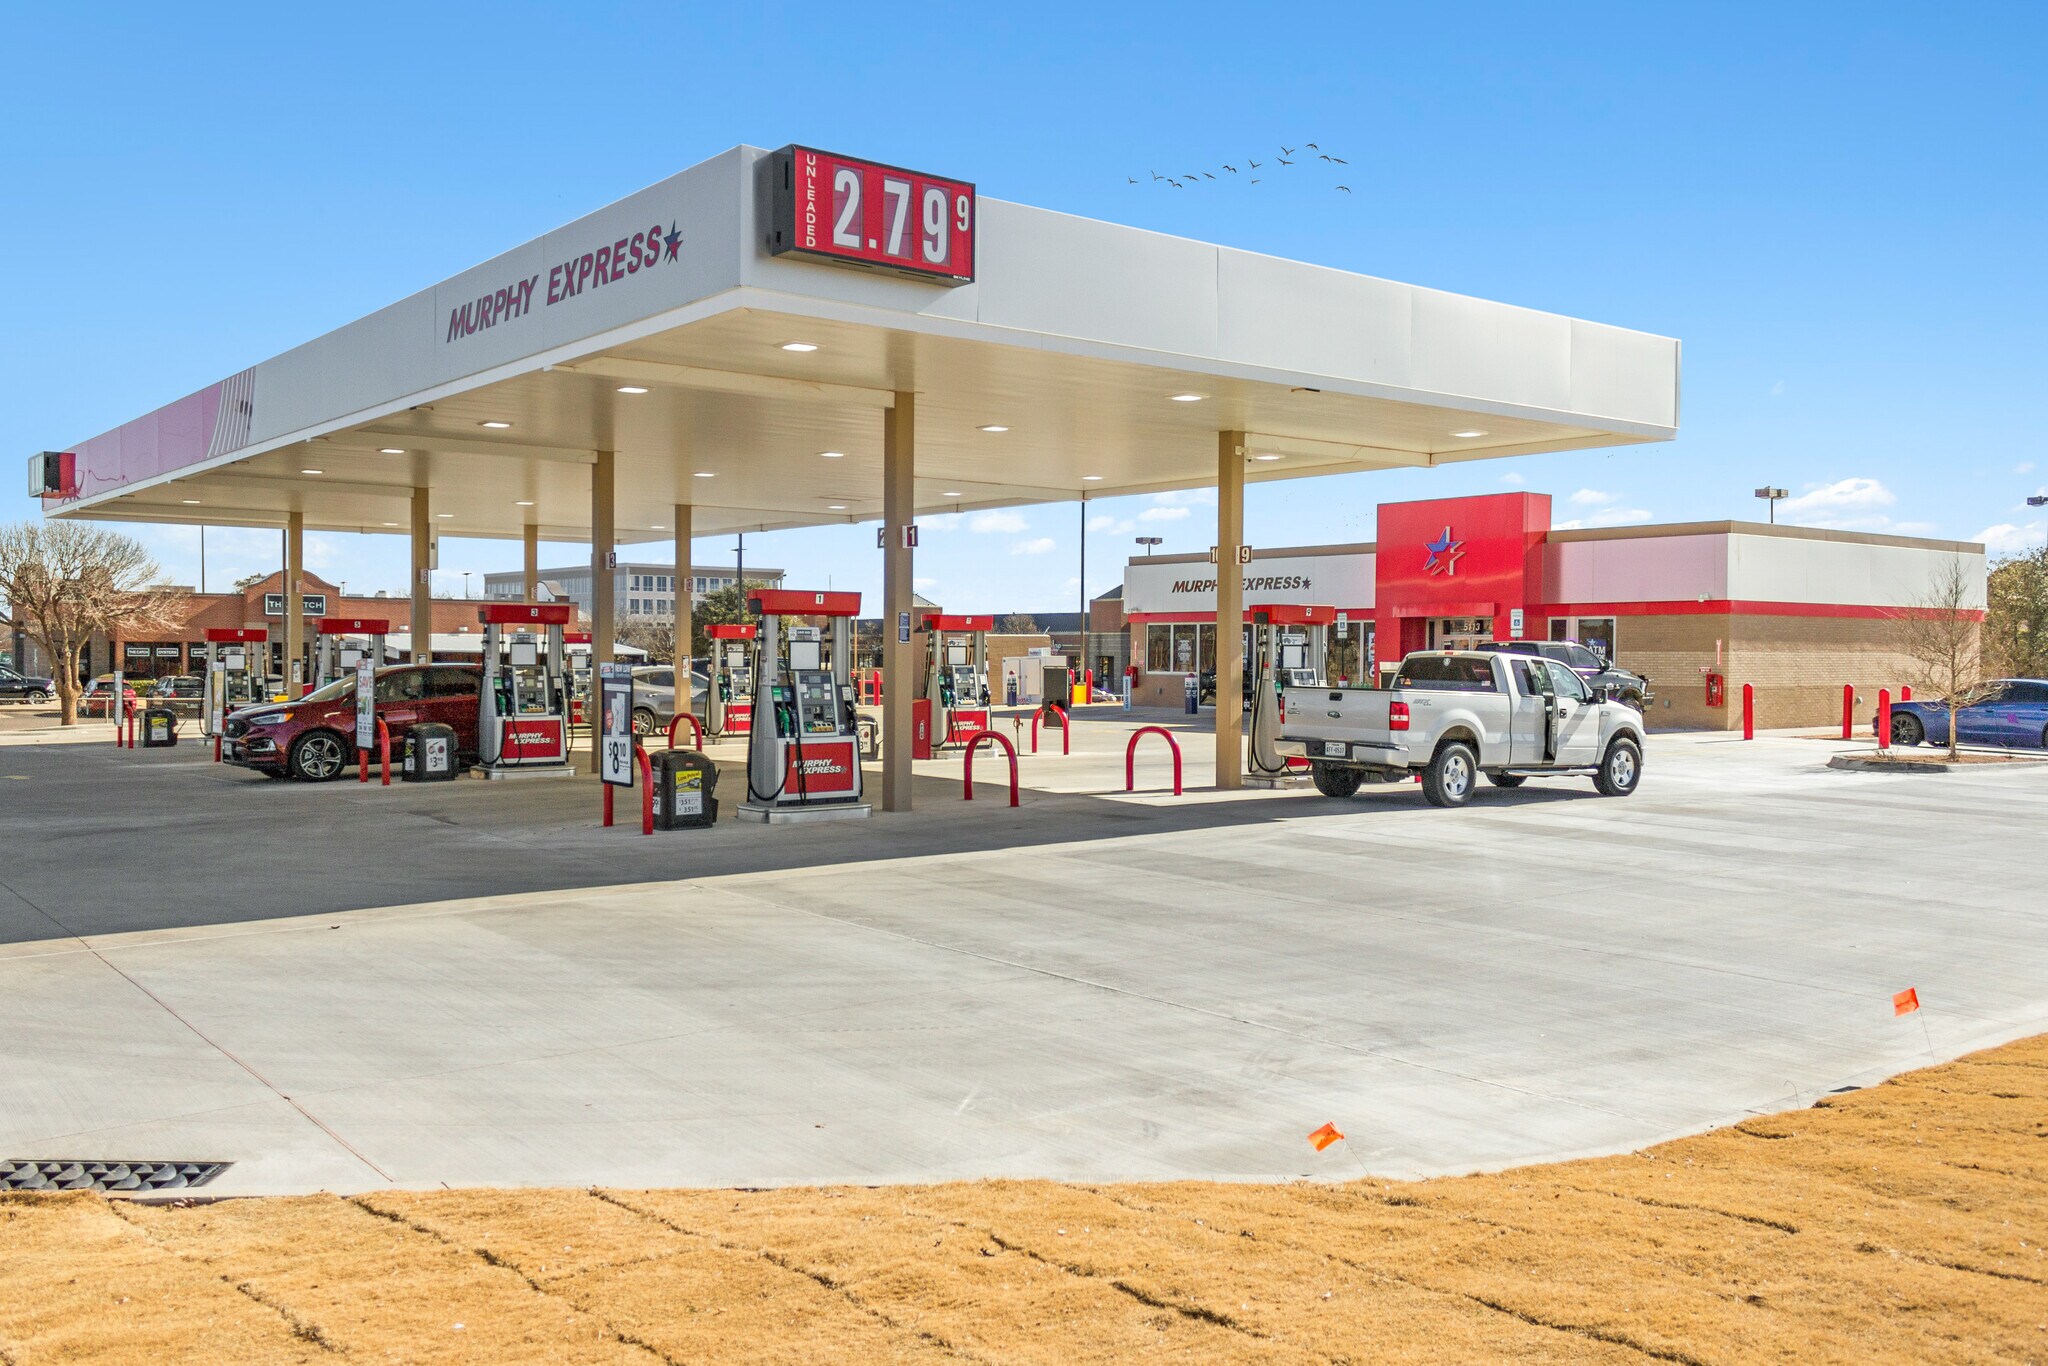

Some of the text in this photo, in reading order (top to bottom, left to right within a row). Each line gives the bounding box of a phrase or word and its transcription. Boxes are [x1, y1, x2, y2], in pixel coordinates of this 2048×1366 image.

[806, 154, 816, 247] UNLEADED
[833, 169, 969, 263] 2.79 9
[446, 224, 662, 343] MURPHY EXPRESS
[910, 527, 915, 546] 1
[609, 552, 616, 568] 3
[1241, 548, 1250, 563] 9
[1172, 579, 1217, 593] MURPH
[531, 608, 538, 616] 3
[1589, 645, 1606, 654] ATM
[799, 765, 842, 775] EXPRESS
